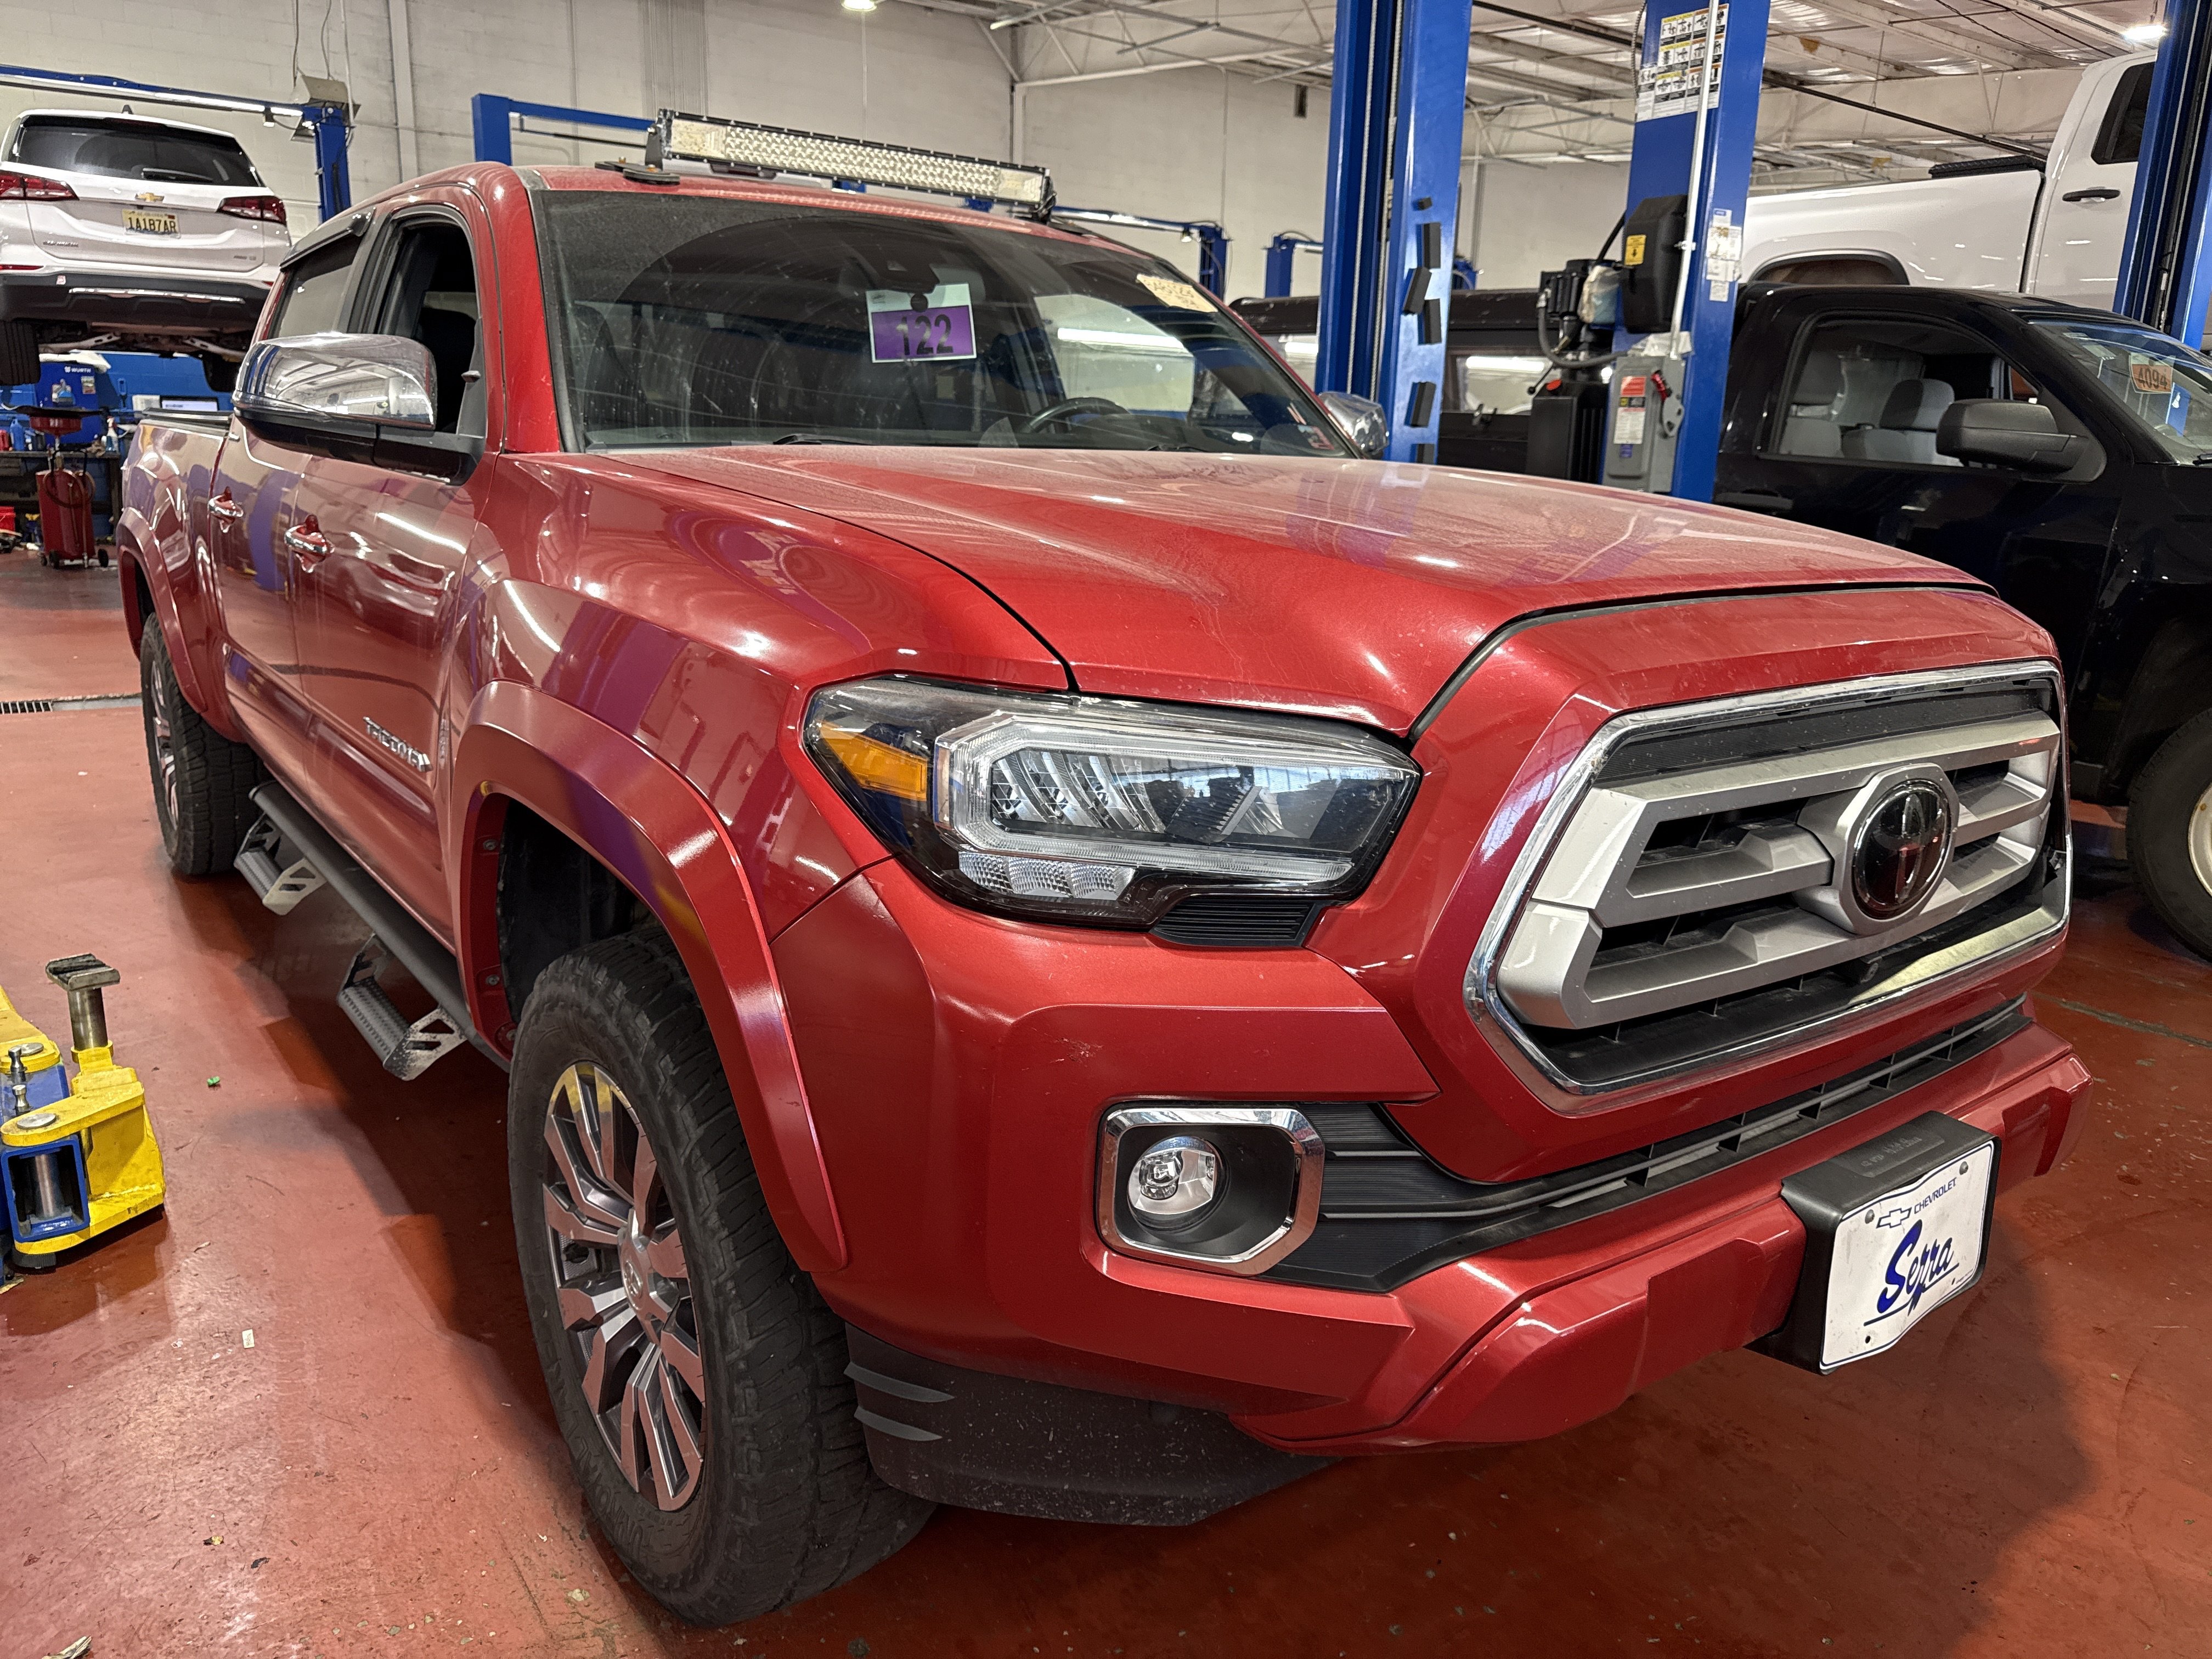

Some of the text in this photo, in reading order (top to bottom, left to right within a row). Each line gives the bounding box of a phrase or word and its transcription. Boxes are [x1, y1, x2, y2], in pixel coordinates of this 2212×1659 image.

[128, 217, 177, 233] 1A1B7AR
[896, 315, 953, 356] 122
[2138, 368, 2168, 389] 4094
[363, 716, 433, 772] TACOMA
[1914, 1177, 1957, 1214] CHEVROLET
[1876, 1219, 1955, 1317] Serra
